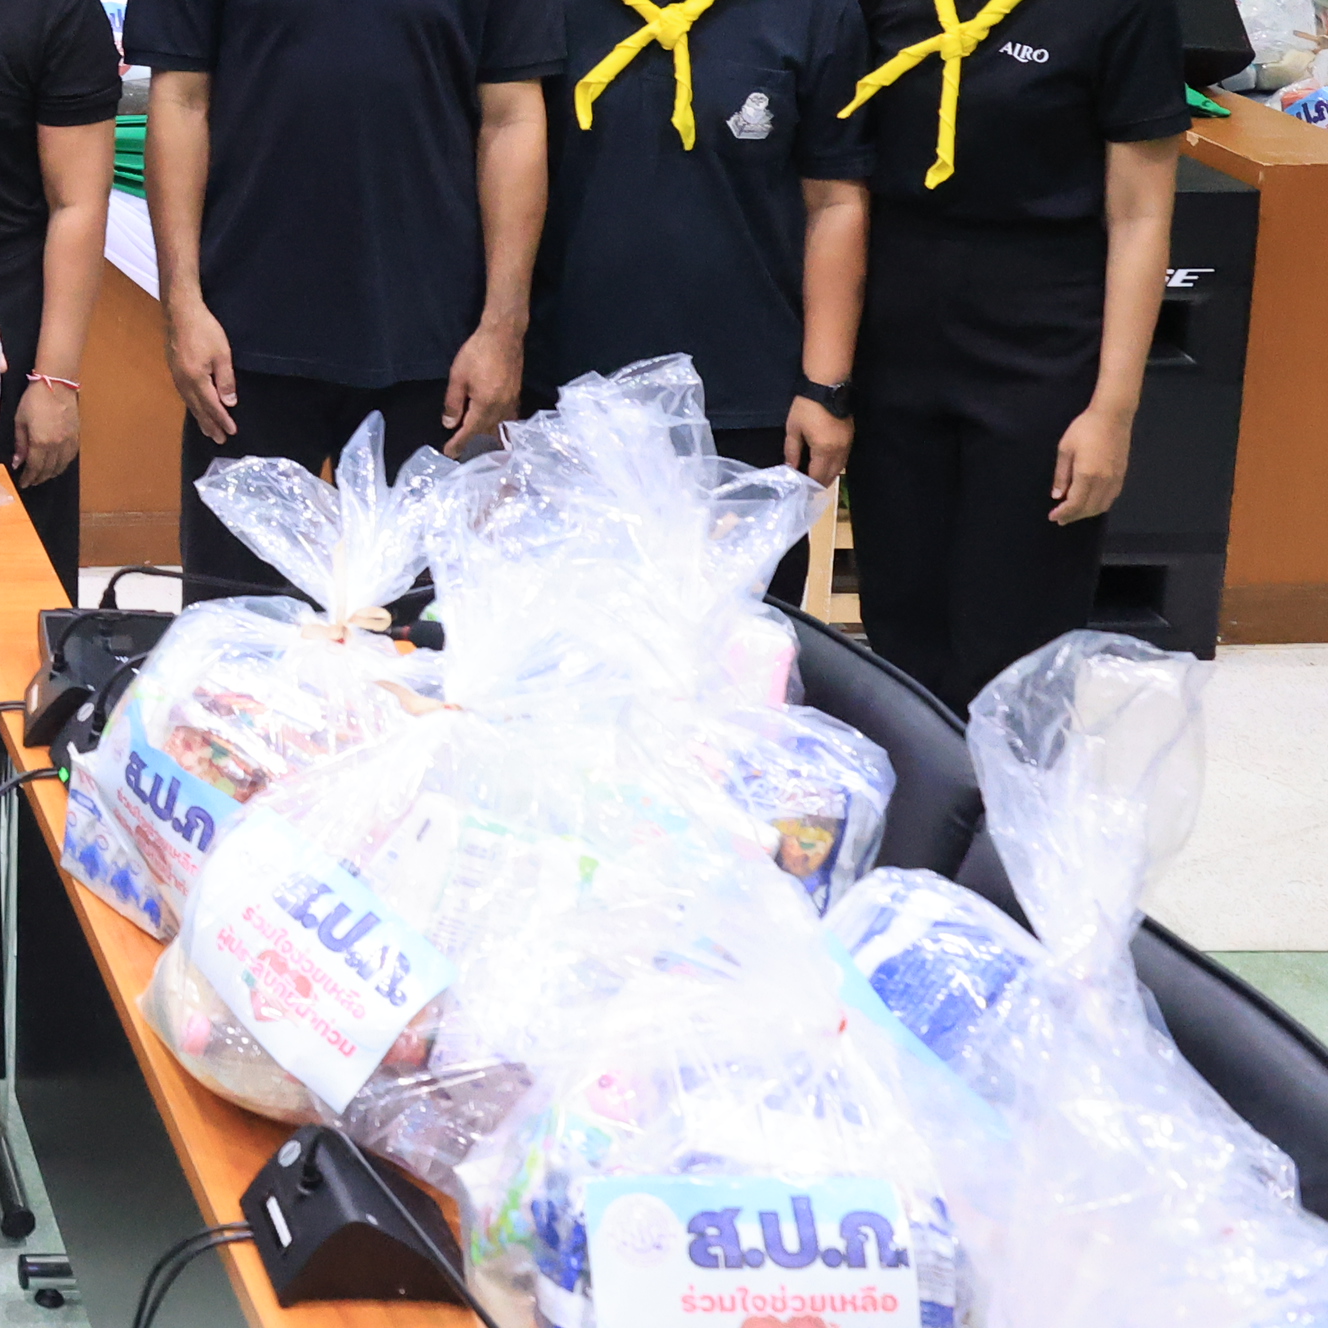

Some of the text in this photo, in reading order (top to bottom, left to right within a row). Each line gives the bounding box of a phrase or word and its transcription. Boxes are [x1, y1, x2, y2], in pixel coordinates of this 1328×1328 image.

[998, 41, 1050, 63] ALRO
[686, 1195, 910, 1270] ส.ป.ก.
[680, 1285, 900, 1313] ร่วมใจช่วยเหลือ
